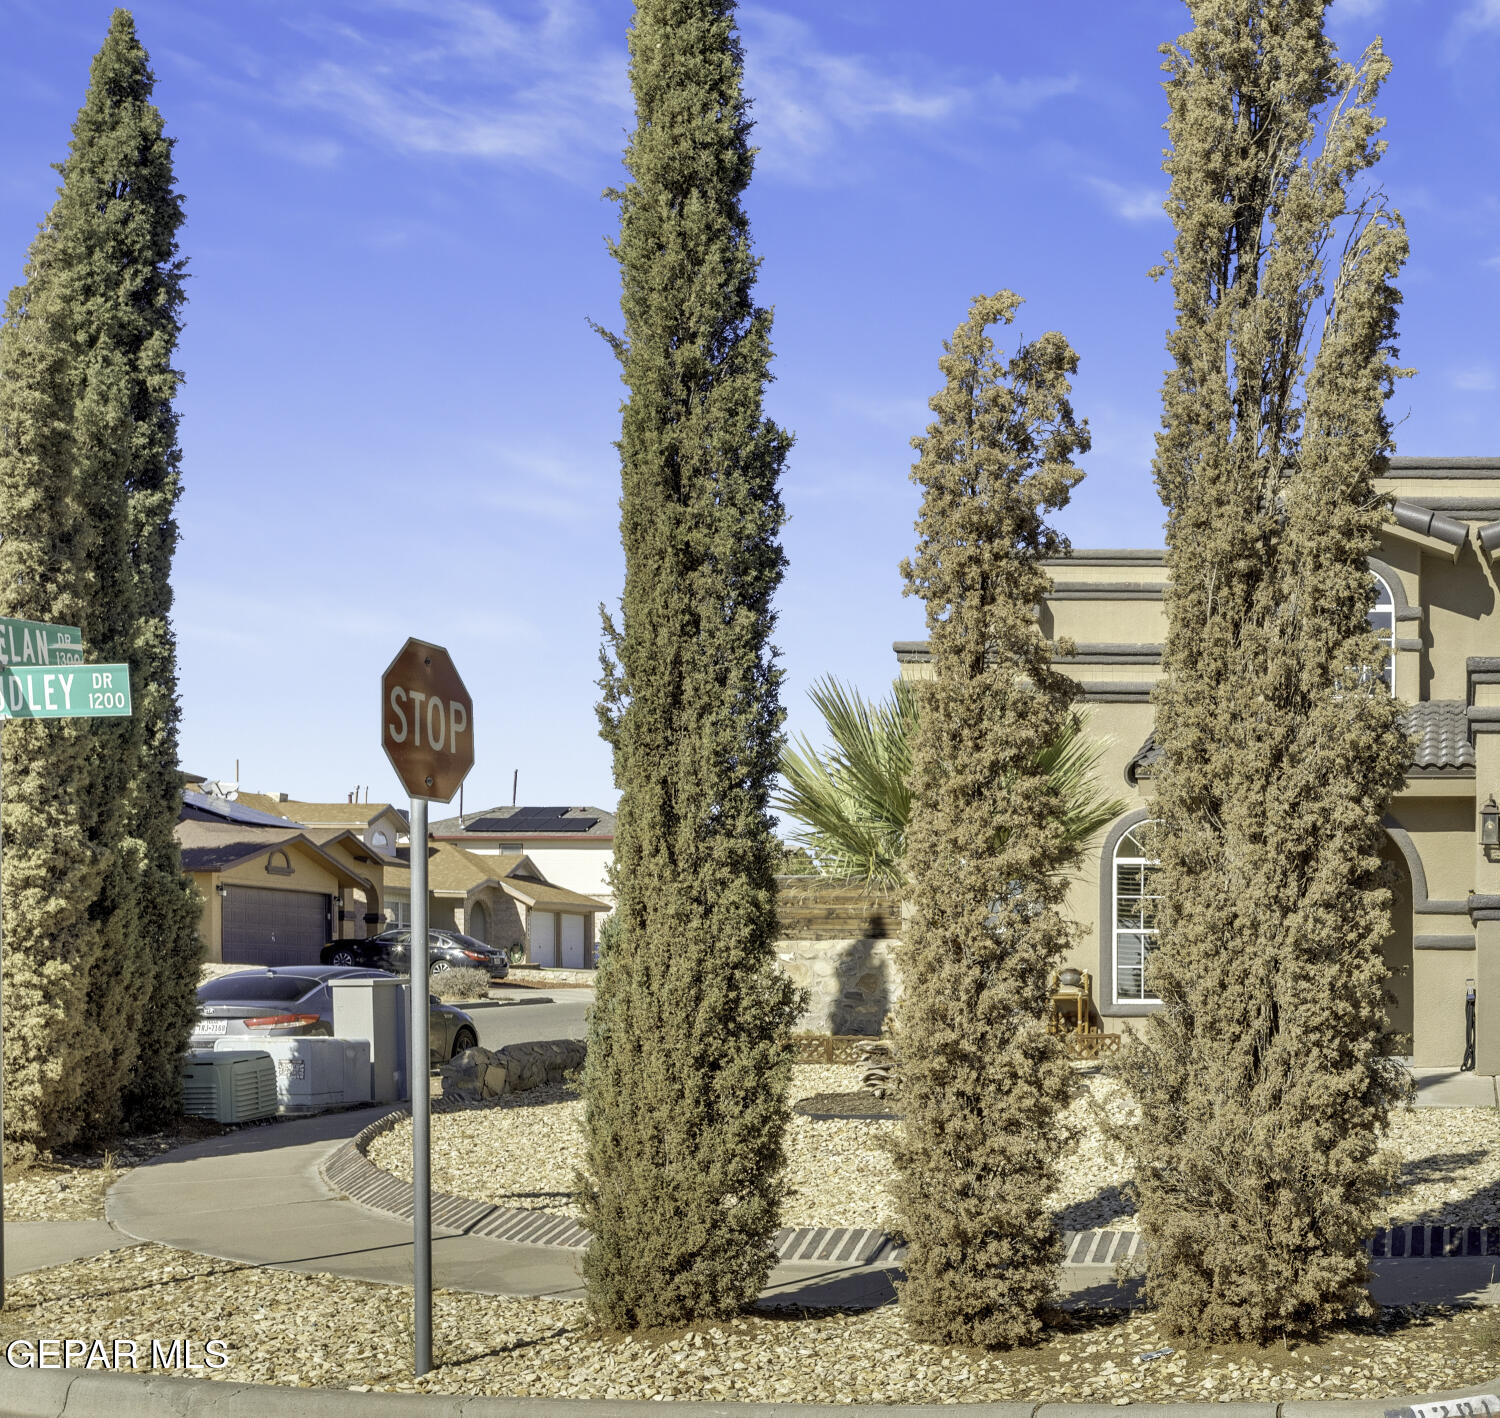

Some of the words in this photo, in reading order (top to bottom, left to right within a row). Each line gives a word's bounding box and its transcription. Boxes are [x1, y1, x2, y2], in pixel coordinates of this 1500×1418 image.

[57, 632, 71, 645] DR
[56, 651, 80, 665] 1300
[92, 672, 113, 689] DR
[88, 692, 125, 709] 1200
[389, 685, 467, 754] STOP
